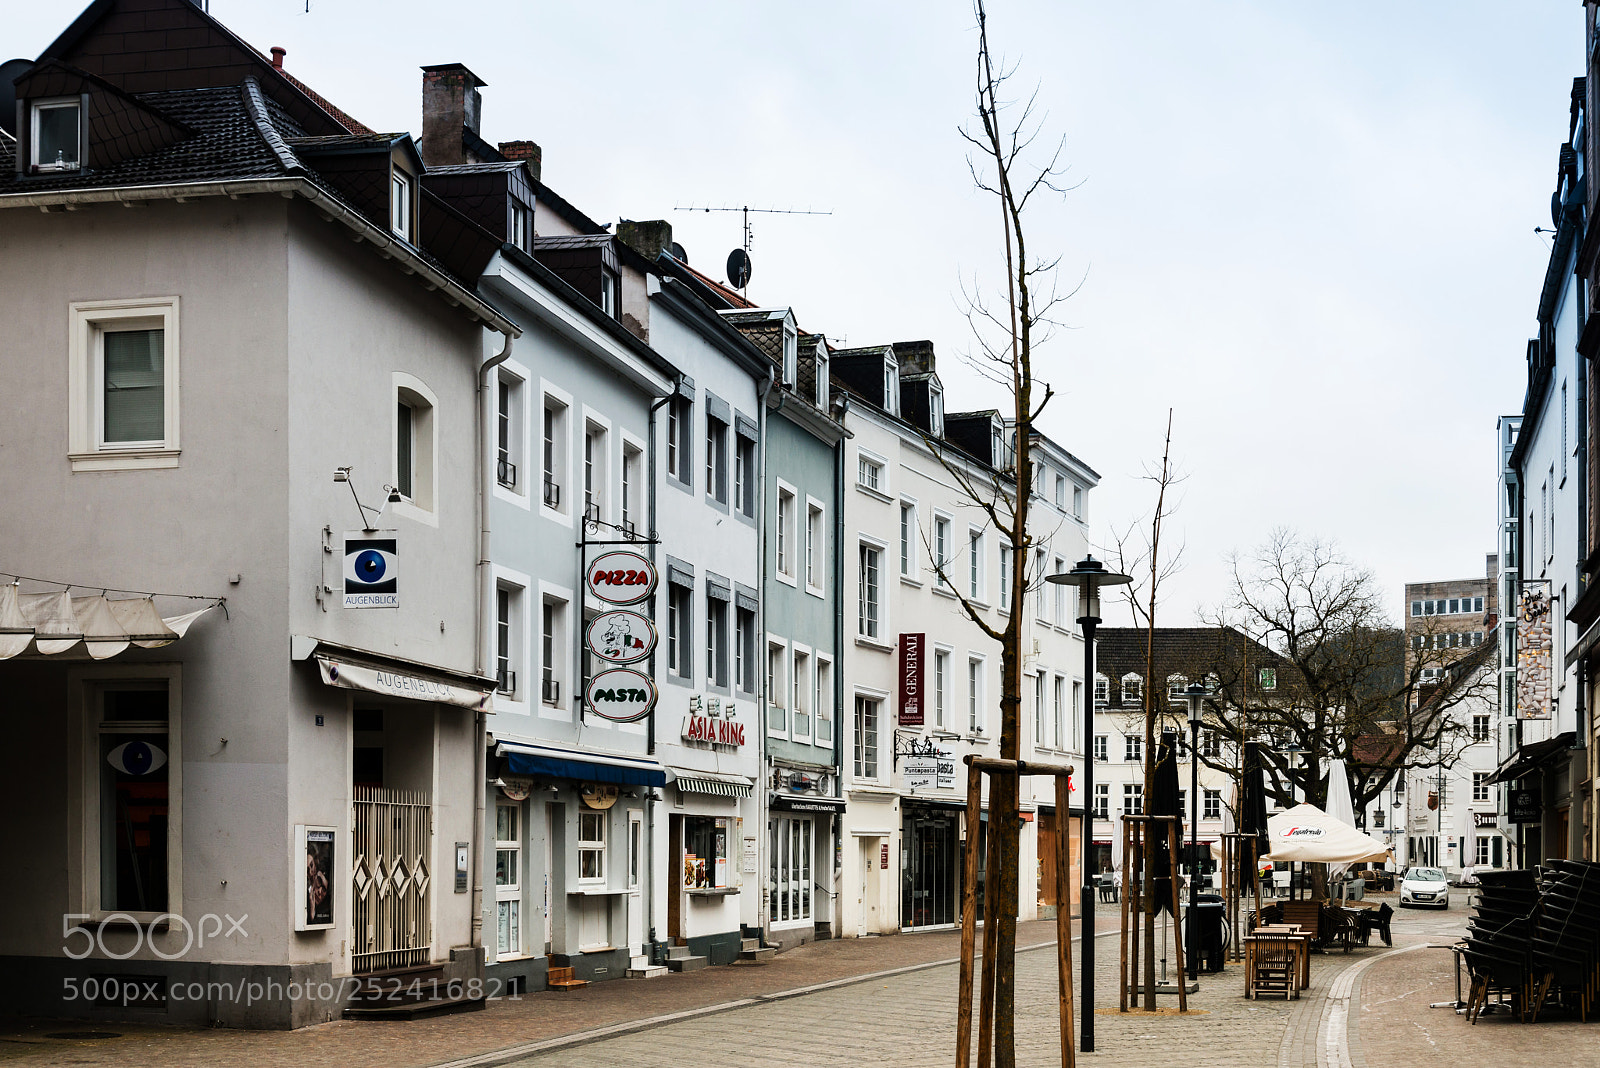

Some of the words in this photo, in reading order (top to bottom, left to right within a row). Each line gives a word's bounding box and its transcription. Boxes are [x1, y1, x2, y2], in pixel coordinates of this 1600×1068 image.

[593, 570, 648, 586] PIZZA
[345, 595, 397, 605] AUGENBLICK
[1521, 590, 1543, 605] Brot
[906, 634, 918, 696] GENERALI
[376, 671, 455, 697] AUGENBLICK
[593, 688, 647, 703] PASTA
[688, 715, 716, 741] ASIA
[719, 719, 745, 746] KING
